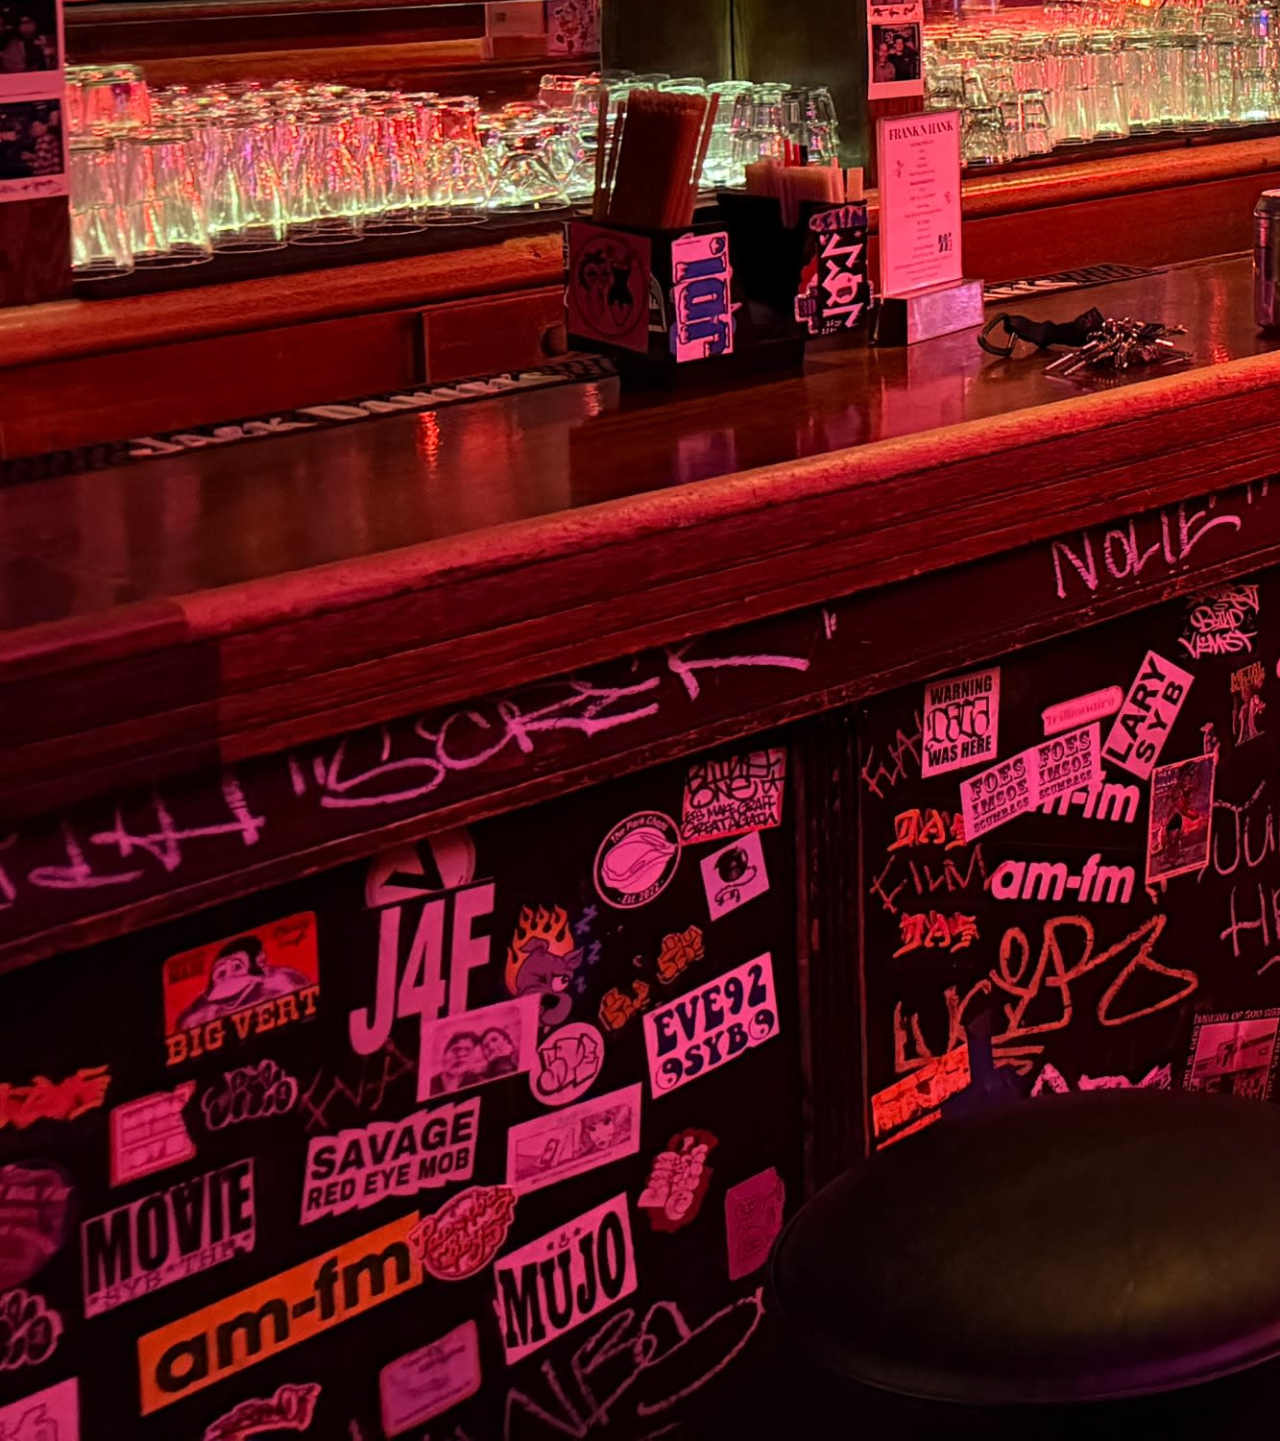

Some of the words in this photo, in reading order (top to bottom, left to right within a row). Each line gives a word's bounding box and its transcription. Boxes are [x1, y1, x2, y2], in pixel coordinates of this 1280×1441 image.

[930, 675, 993, 706] WARNING
[1105, 657, 1167, 765] LARY
[928, 745, 958, 768] WAS
[960, 736, 992, 759] HERE
[970, 757, 1026, 802] FOES
[1038, 729, 1092, 768] FOES
[990, 853, 1136, 904] am-fm
[350, 882, 496, 1056] J4F
[166, 1020, 226, 1067] BIG
[231, 985, 321, 1040] VERT
[653, 963, 767, 1058] EVE92
[306, 1176, 357, 1211] RED
[363, 1163, 411, 1197] EYE
[417, 1146, 471, 1182] MOB
[311, 1110, 476, 1182] SAVAGE
[85, 1160, 253, 1294] MOVIE
[155, 1240, 411, 1393] am-fm
